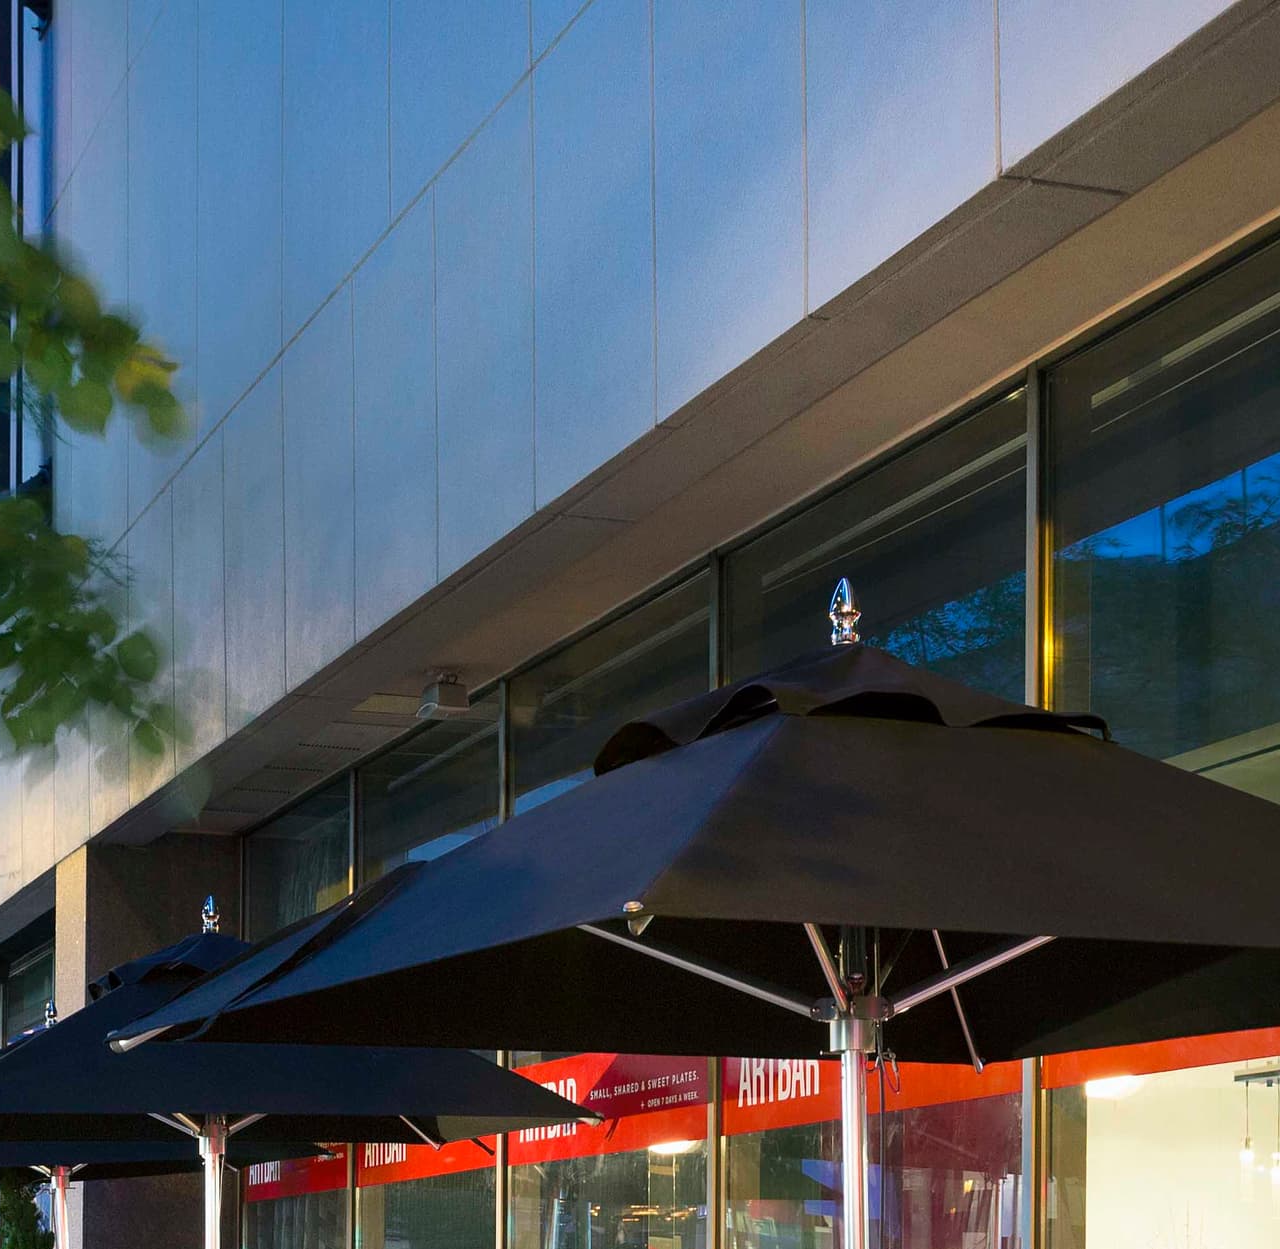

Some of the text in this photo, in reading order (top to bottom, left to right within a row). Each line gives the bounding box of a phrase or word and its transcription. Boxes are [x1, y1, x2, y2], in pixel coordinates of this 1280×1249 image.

[590, 1088, 612, 1101] SMALL,
[614, 1082, 639, 1096] SHARED
[647, 1075, 669, 1090] SWEET
[672, 1070, 699, 1085] PLATES.
[647, 1098, 661, 1108] OPEN
